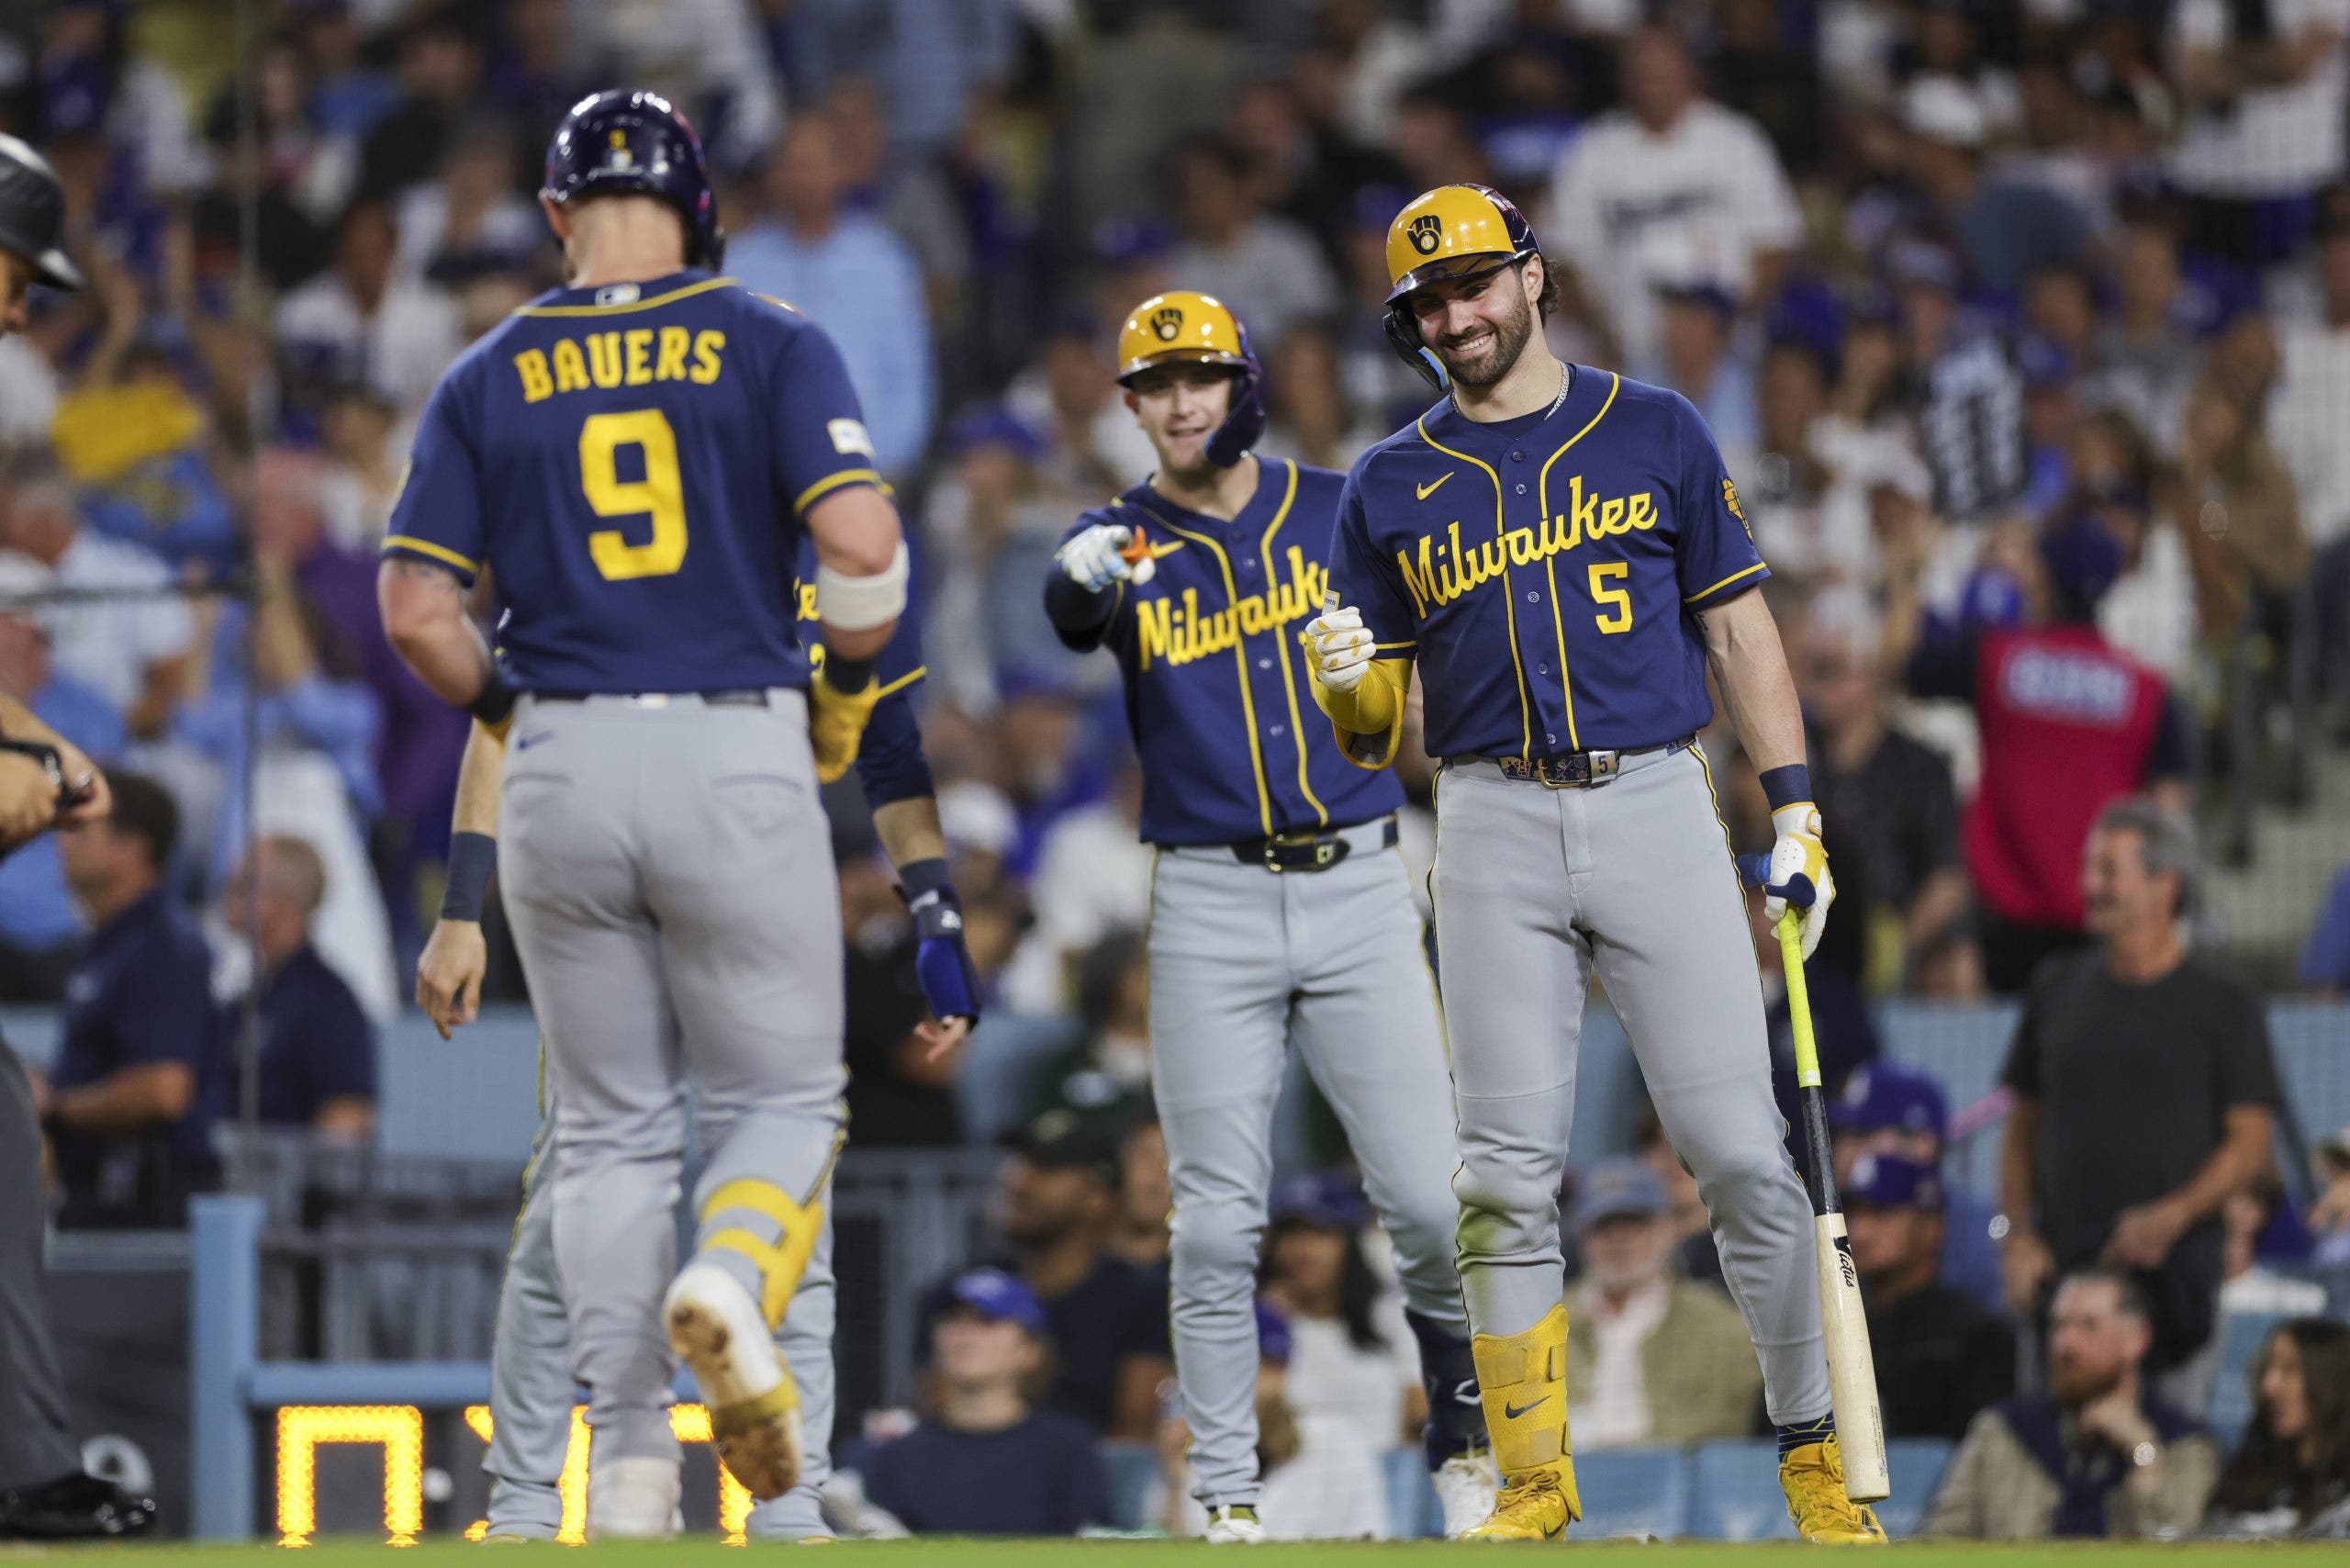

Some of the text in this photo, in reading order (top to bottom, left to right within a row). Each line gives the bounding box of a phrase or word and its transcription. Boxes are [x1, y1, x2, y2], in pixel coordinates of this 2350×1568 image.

[513, 326, 726, 404] BAUERS
[578, 408, 688, 581] 9
[1397, 475, 1659, 620] Milwaukee
[1588, 561, 1633, 634] 5
[1136, 545, 1328, 672] Milwauk
[1597, 755, 1607, 774] 5
